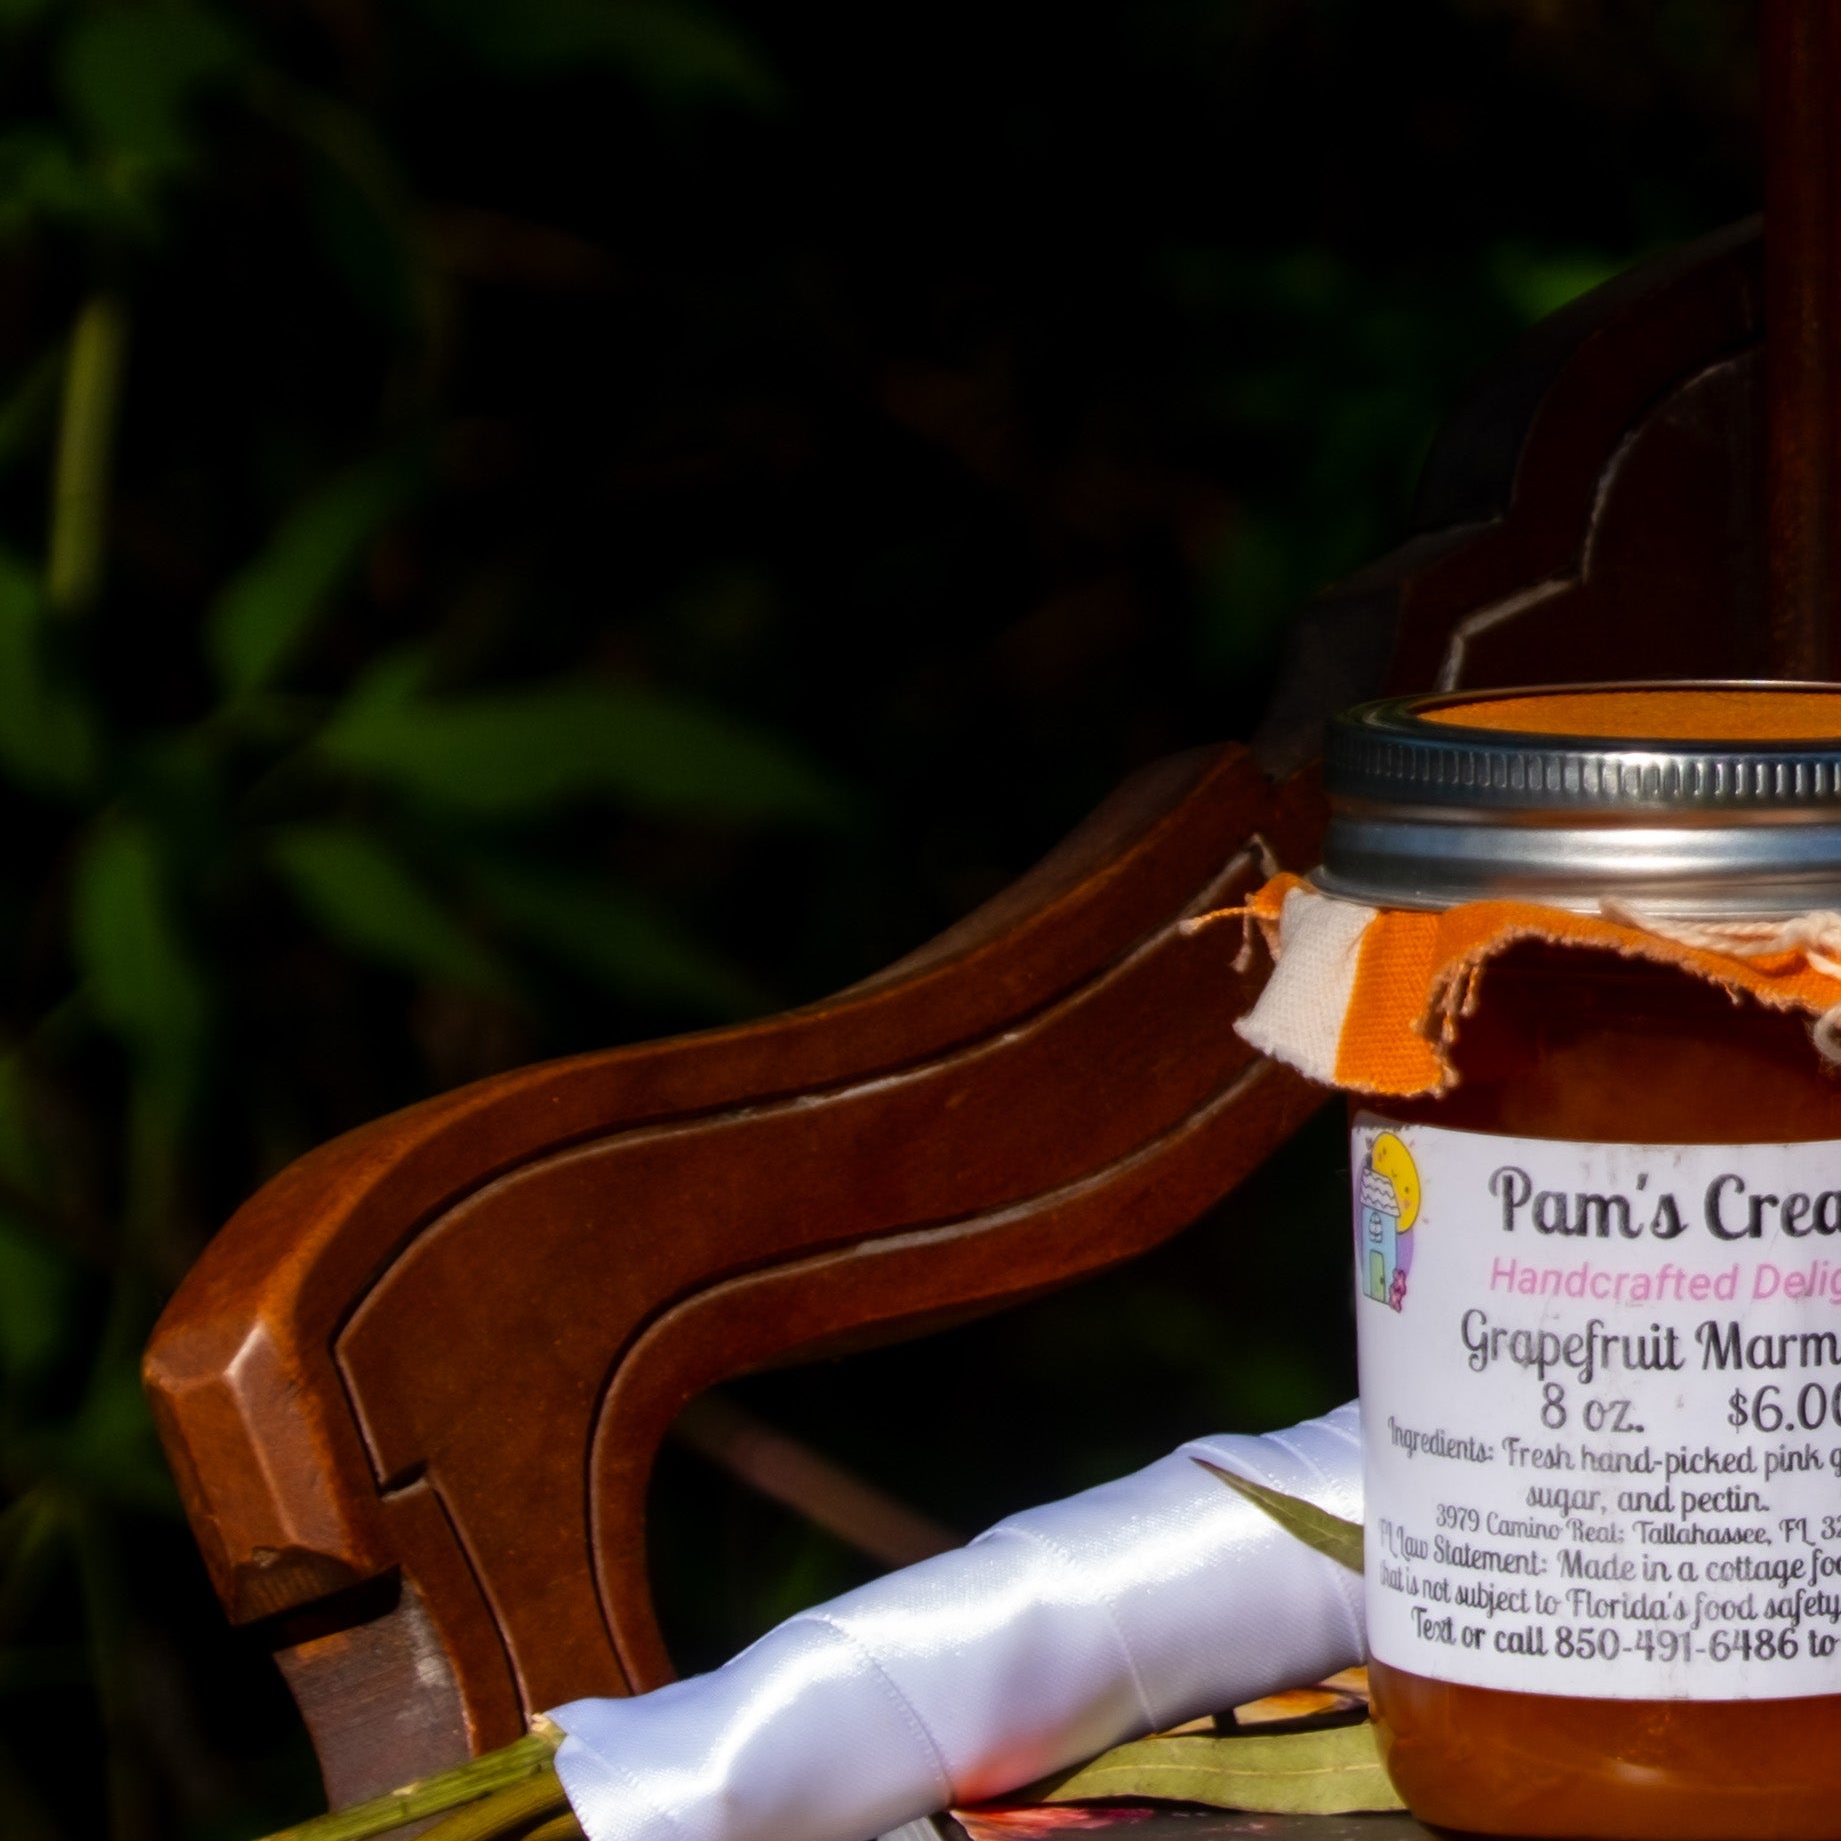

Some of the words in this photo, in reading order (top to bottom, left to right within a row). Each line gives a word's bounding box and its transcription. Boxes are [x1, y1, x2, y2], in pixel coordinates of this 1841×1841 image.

[1488, 1165, 1688, 1240] Pam's
[1490, 1256, 1740, 1302] Handcrafted
[1461, 1308, 1686, 1384] Grapefruit
[1540, 1381, 1568, 1430] 8
[1582, 1399, 1645, 1433] oz.
[1387, 1415, 1494, 1463] Ingredients:
[1502, 1436, 1575, 1471] Fresh
[1581, 1445, 1757, 1483] hand-picked
[1764, 1443, 1824, 1482] pink
[1435, 1503, 1481, 1532] 3979
[1486, 1510, 1562, 1540] Camino
[1632, 1520, 1773, 1547] Tallahassee,
[1778, 1517, 1817, 1547] FL
[1526, 1485, 1608, 1517] sugar,
[1617, 1485, 1676, 1513] and
[1681, 1484, 1770, 1521] pectin.
[1433, 1534, 1549, 1576] Statement:
[1556, 1548, 1637, 1582] Made
[1642, 1554, 1673, 1582] in
[1677, 1560, 1699, 1582] a
[1705, 1555, 1807, 1588] cottage
[1406, 1566, 1420, 1596] is
[1422, 1577, 1452, 1604] not
[1455, 1580, 1532, 1619] subject
[1535, 1589, 1562, 1616] to
[1565, 1587, 1688, 1622] Florida's
[1690, 1590, 1758, 1631] food
[1411, 1605, 1457, 1646] Text
[1461, 1628, 1486, 1650] or
[1494, 1625, 1549, 1657] call
[1554, 1625, 1800, 1662] 850-491-6486
[1808, 1628, 1840, 1659] to
